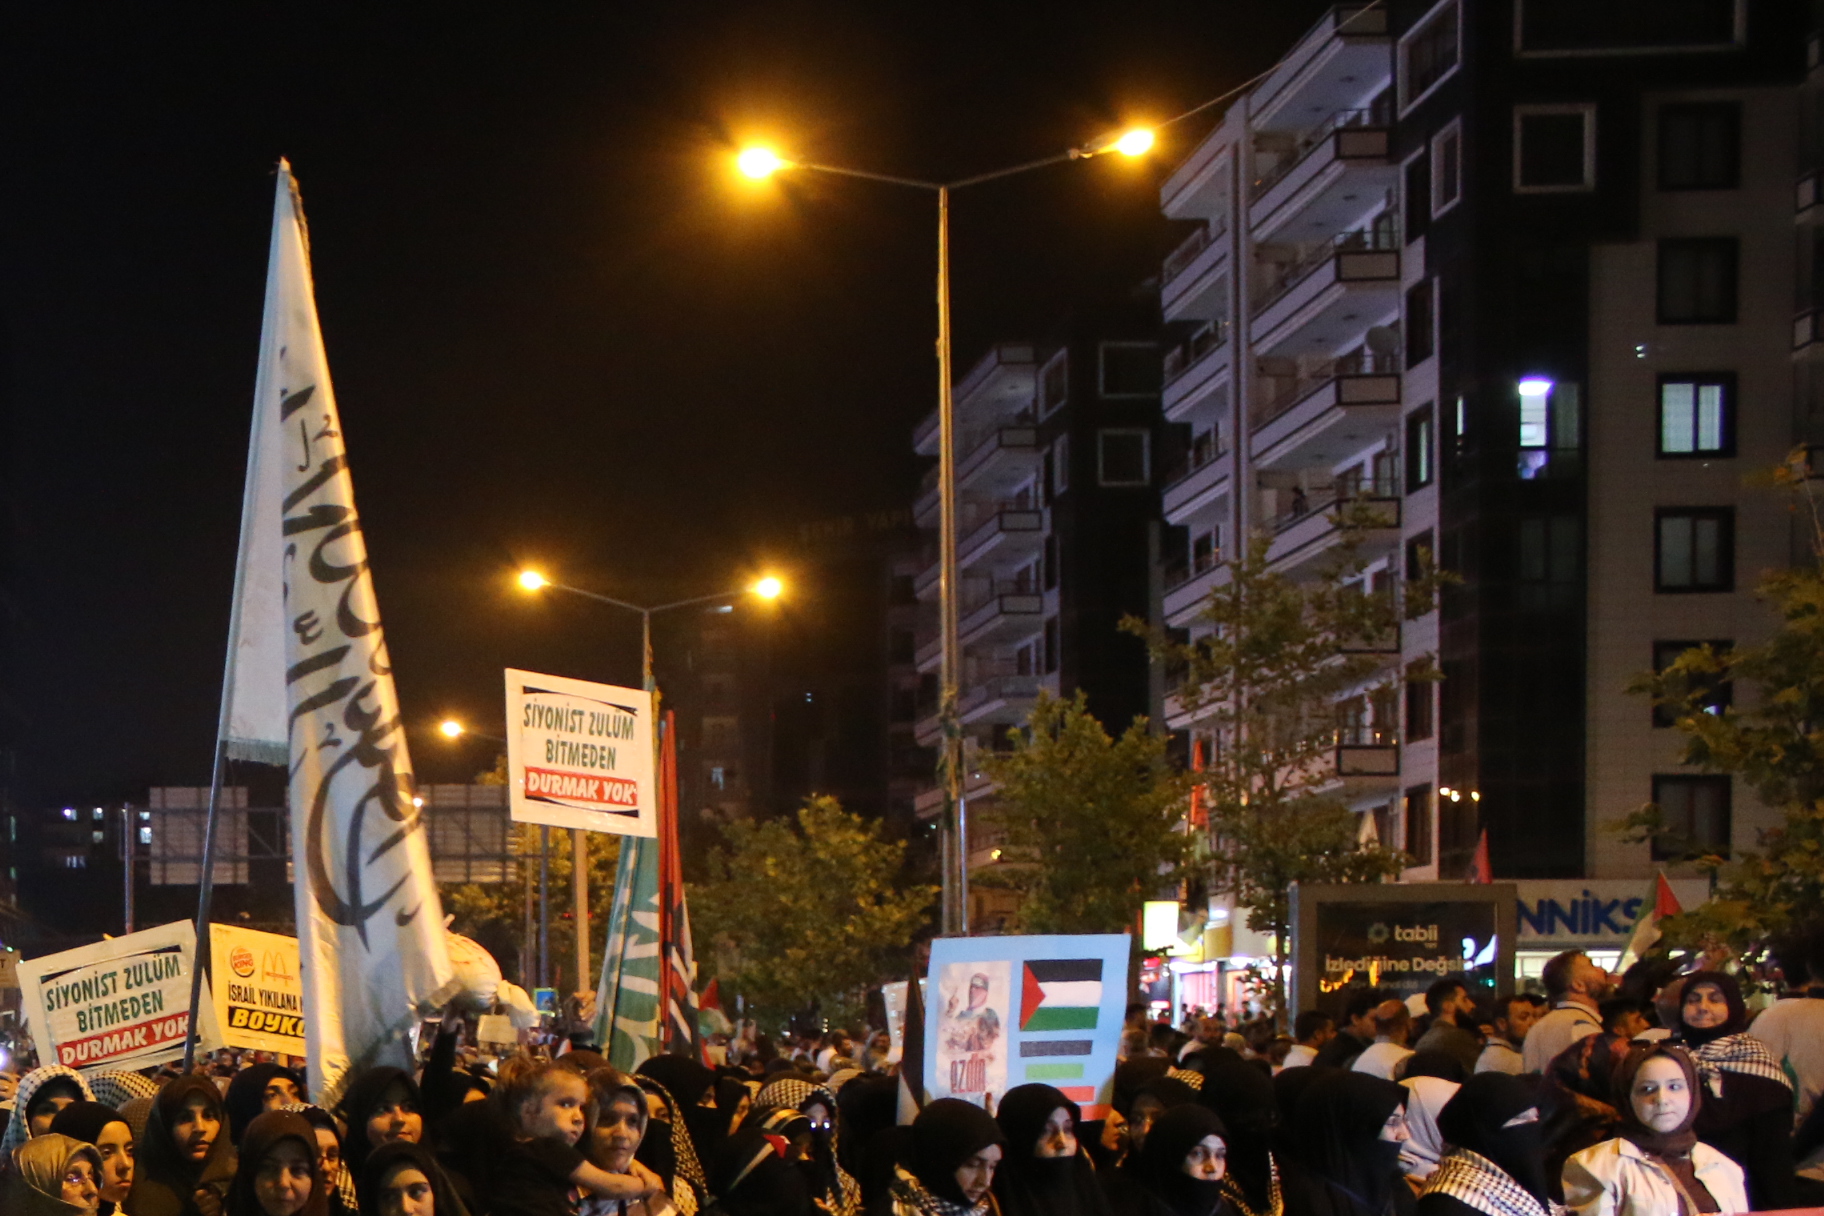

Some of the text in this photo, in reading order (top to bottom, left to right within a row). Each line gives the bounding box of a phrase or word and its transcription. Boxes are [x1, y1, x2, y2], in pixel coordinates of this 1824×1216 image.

[523, 697, 635, 741] SİYONİST ZULÜM
[545, 734, 617, 771] BİTMEDEN
[528, 771, 636, 805] DURMAK YOK
[46, 953, 181, 1012] SİYONİST ZULÜM
[228, 980, 256, 1005] İSRAİL
[259, 989, 298, 1012] YIKILANA
[76, 989, 164, 1033] BİTMEDEN
[62, 1016, 190, 1065] DURMAK YOK
